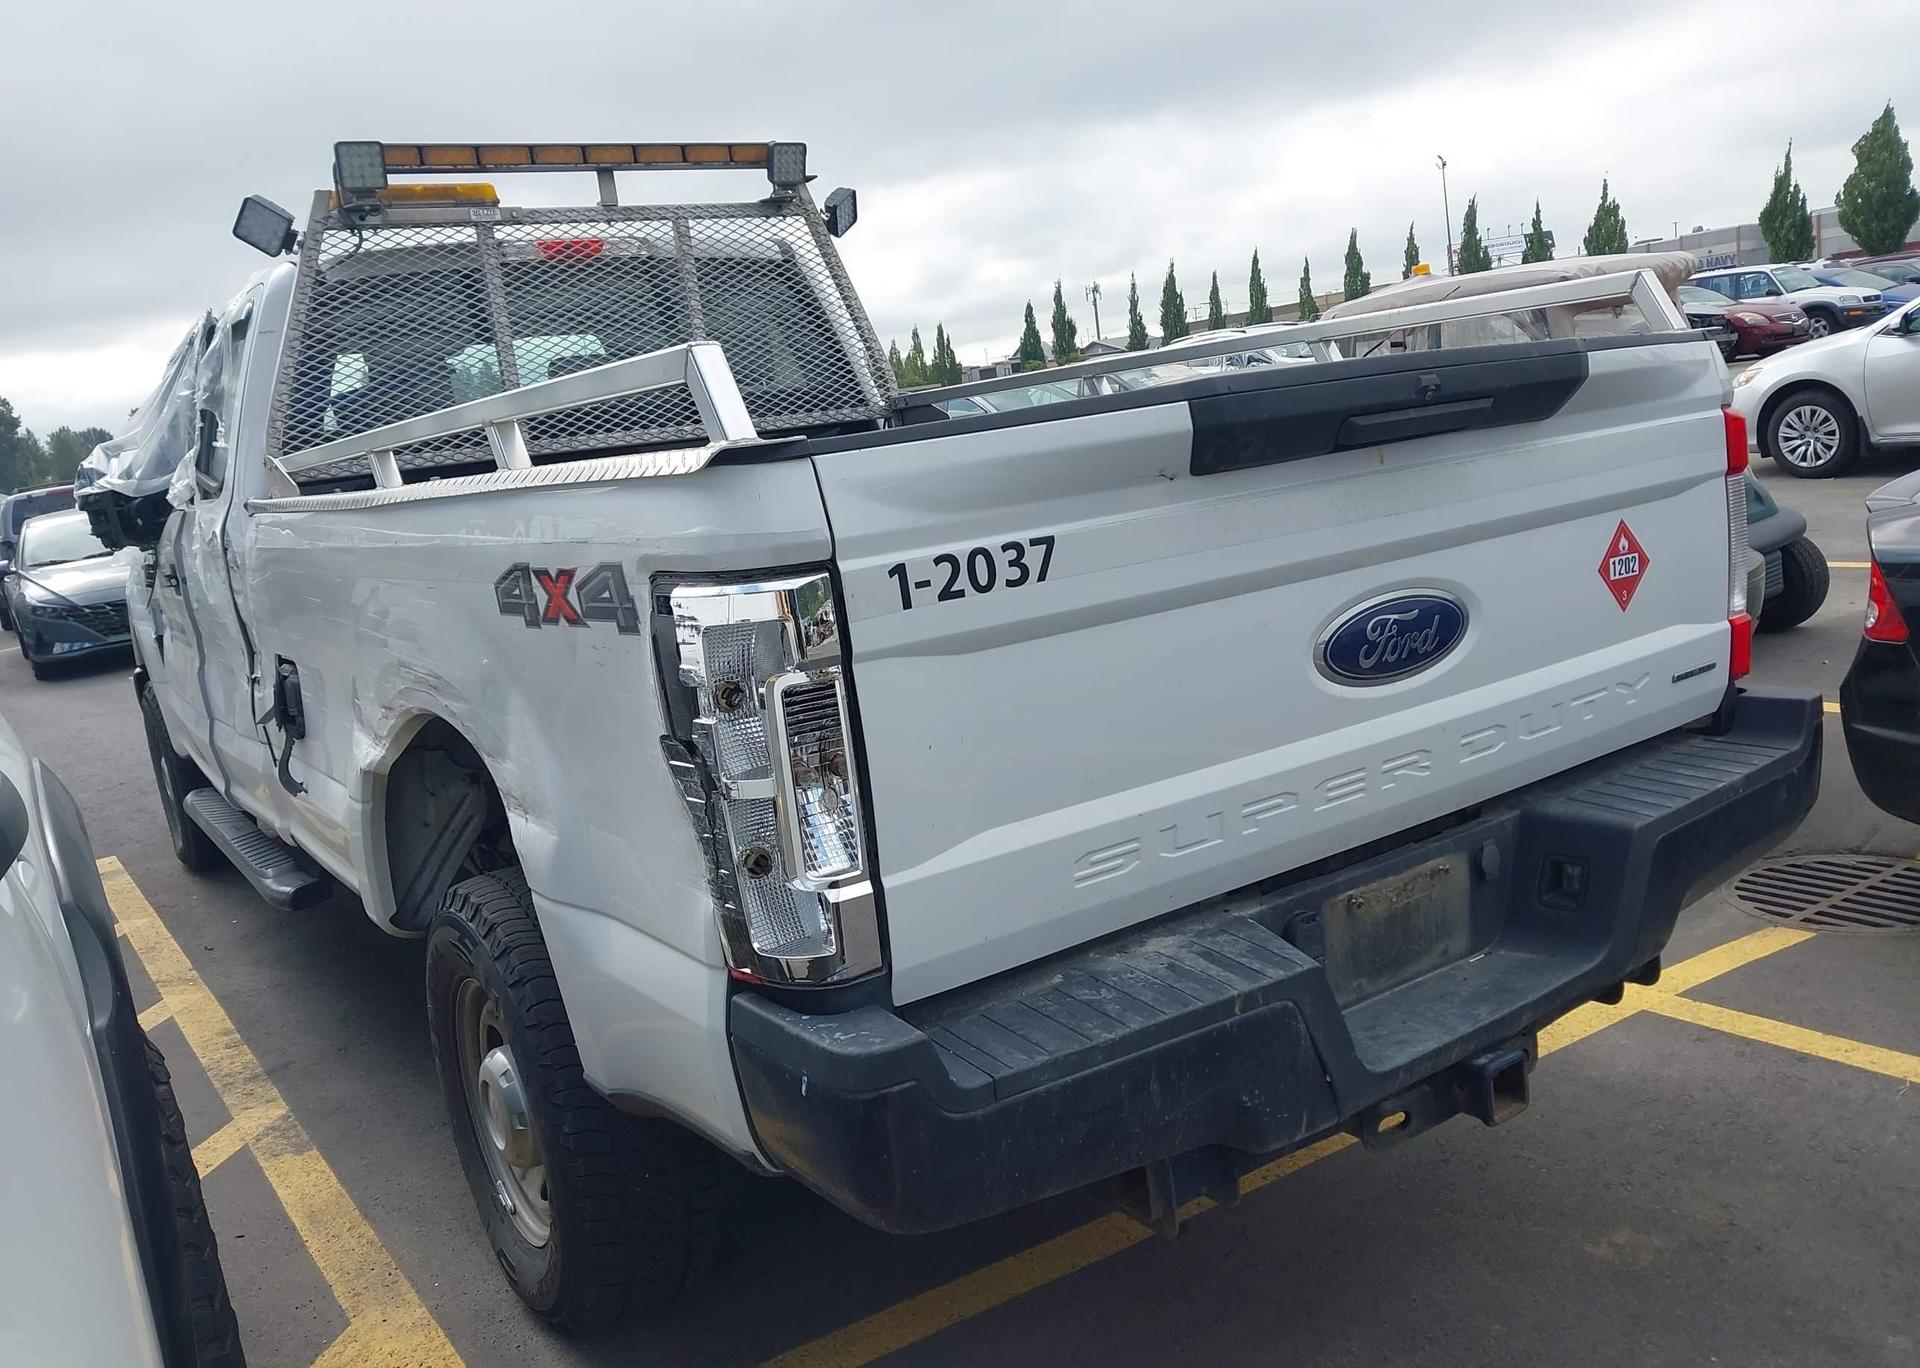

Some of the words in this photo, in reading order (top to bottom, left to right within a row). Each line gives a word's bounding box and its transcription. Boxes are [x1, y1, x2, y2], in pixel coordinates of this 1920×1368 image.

[1705, 254, 1736, 268] NAVY
[888, 535, 1056, 611] 1-2037
[1611, 555, 1638, 578] 1202
[1622, 590, 1628, 601] 3
[1358, 608, 1440, 669] Ford
[1073, 748, 1433, 889] SUPER
[1459, 672, 1651, 764] DUTY
